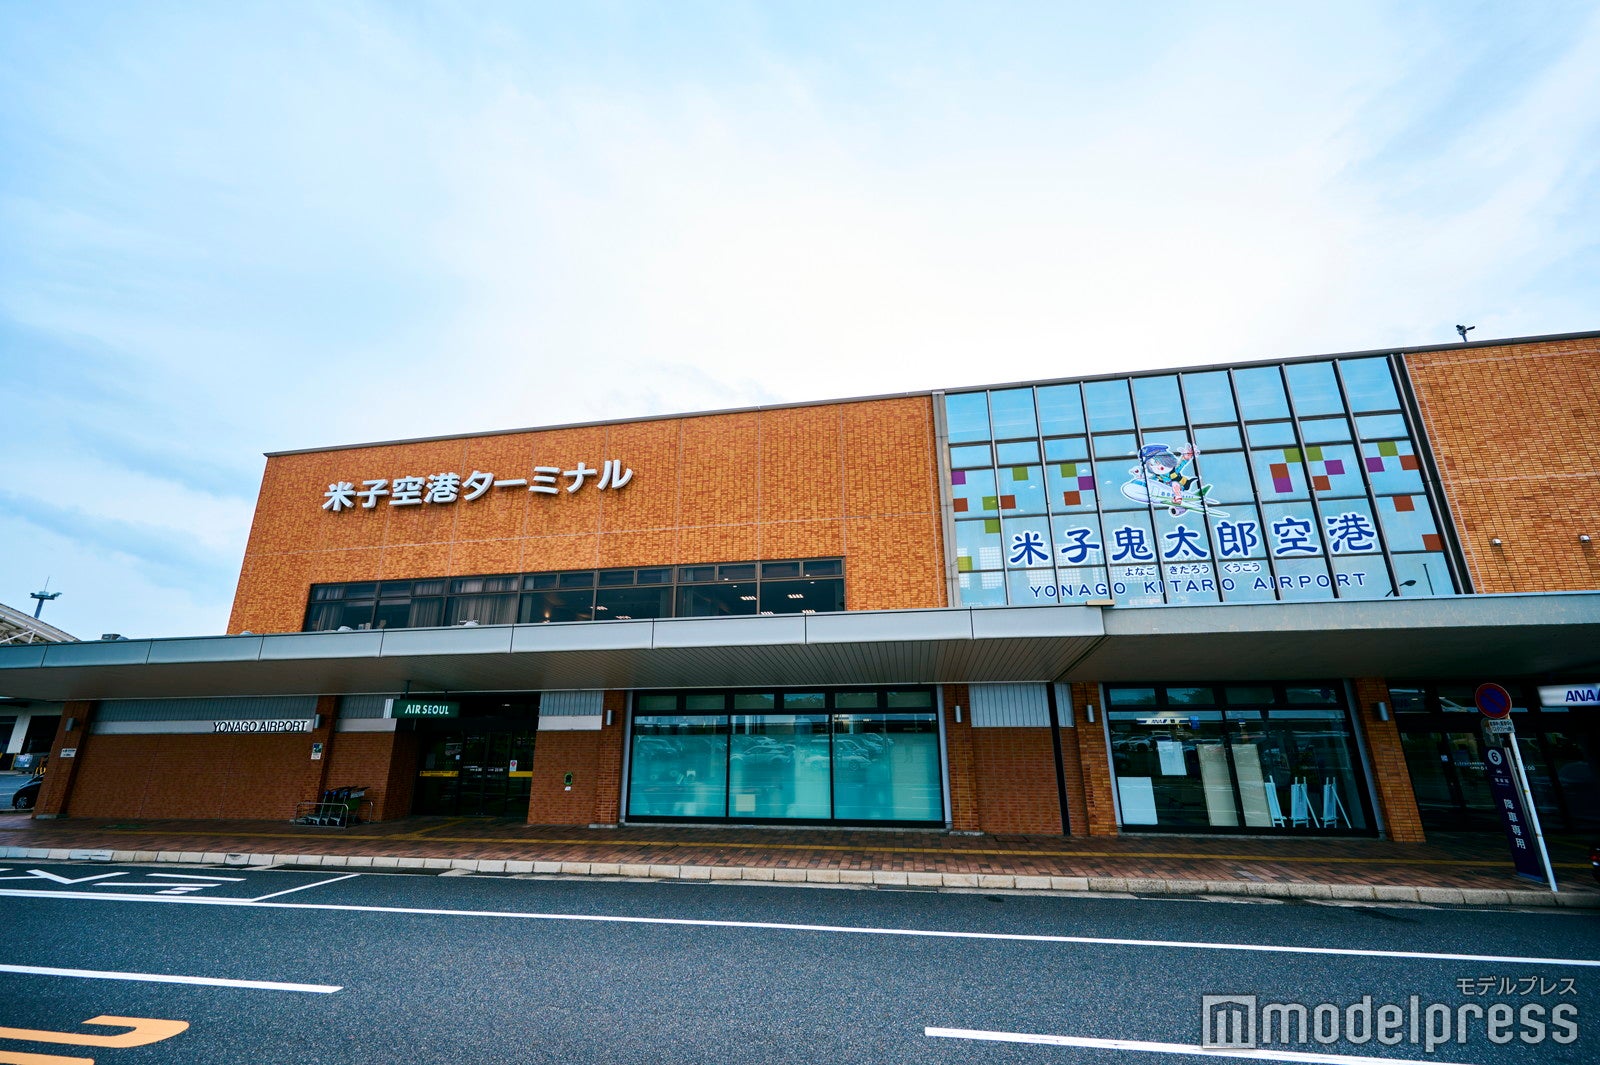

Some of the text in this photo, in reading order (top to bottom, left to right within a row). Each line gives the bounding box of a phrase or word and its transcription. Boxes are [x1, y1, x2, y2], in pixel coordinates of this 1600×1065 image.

[321, 458, 634, 512] 米子空港ターミナル
[1009, 512, 1376, 566] 米子鬼太郎空港
[1125, 562, 1261, 577] よなご きたろう くうこう
[1030, 573, 1366, 598] YONAGO KITARO AIRPORT
[1565, 689, 1596, 703] ANA
[404, 704, 449, 715] AIR SEOUL
[213, 720, 308, 733] YONAGO AIRPORT
